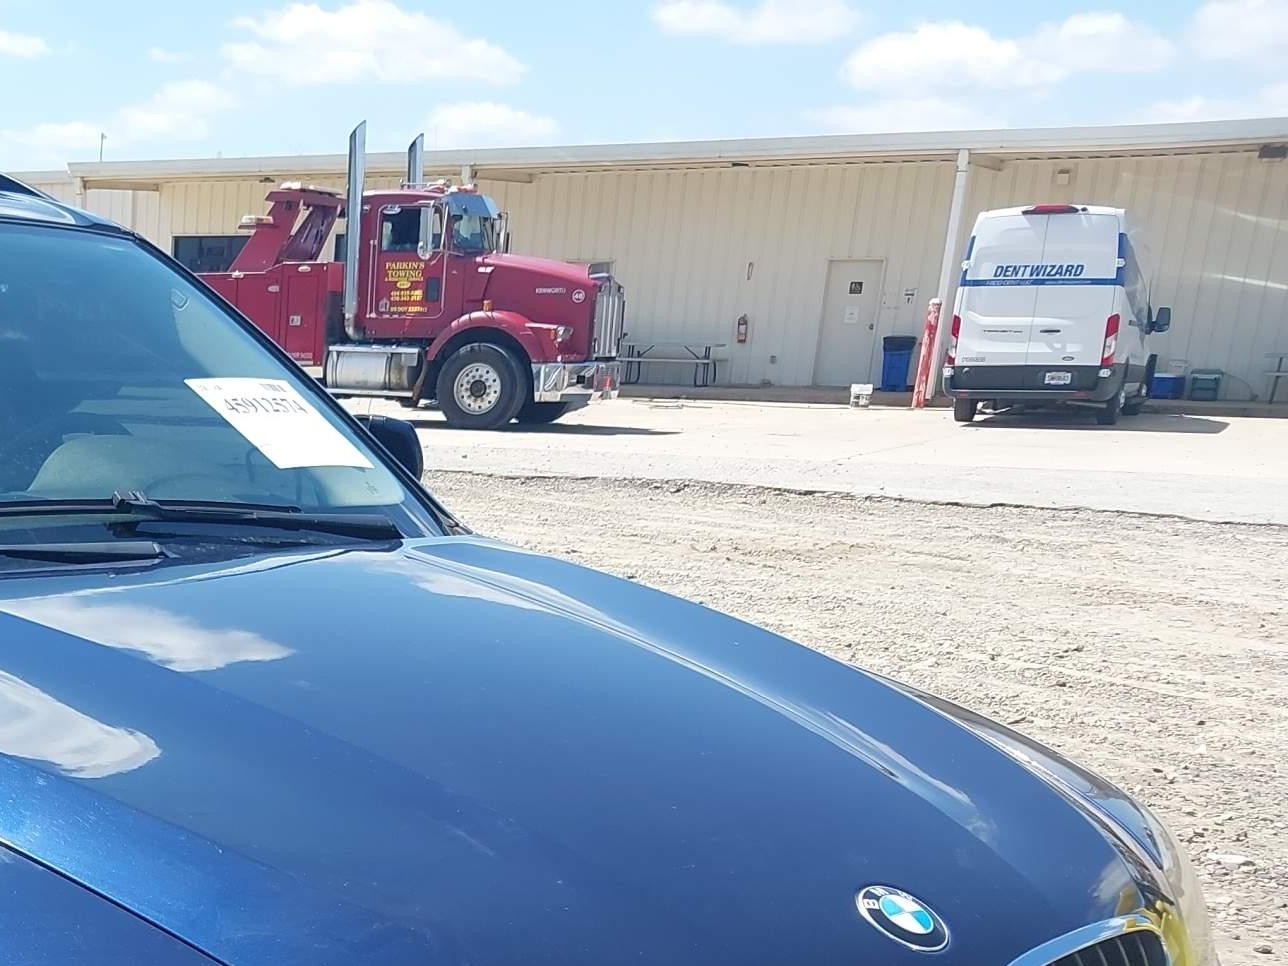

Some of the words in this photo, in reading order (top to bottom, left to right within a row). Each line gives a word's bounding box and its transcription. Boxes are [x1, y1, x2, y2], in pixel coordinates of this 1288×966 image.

[385, 261, 425, 270] PARKIN'S
[387, 270, 423, 279] TOWING
[223, 397, 309, 414] 45912574
